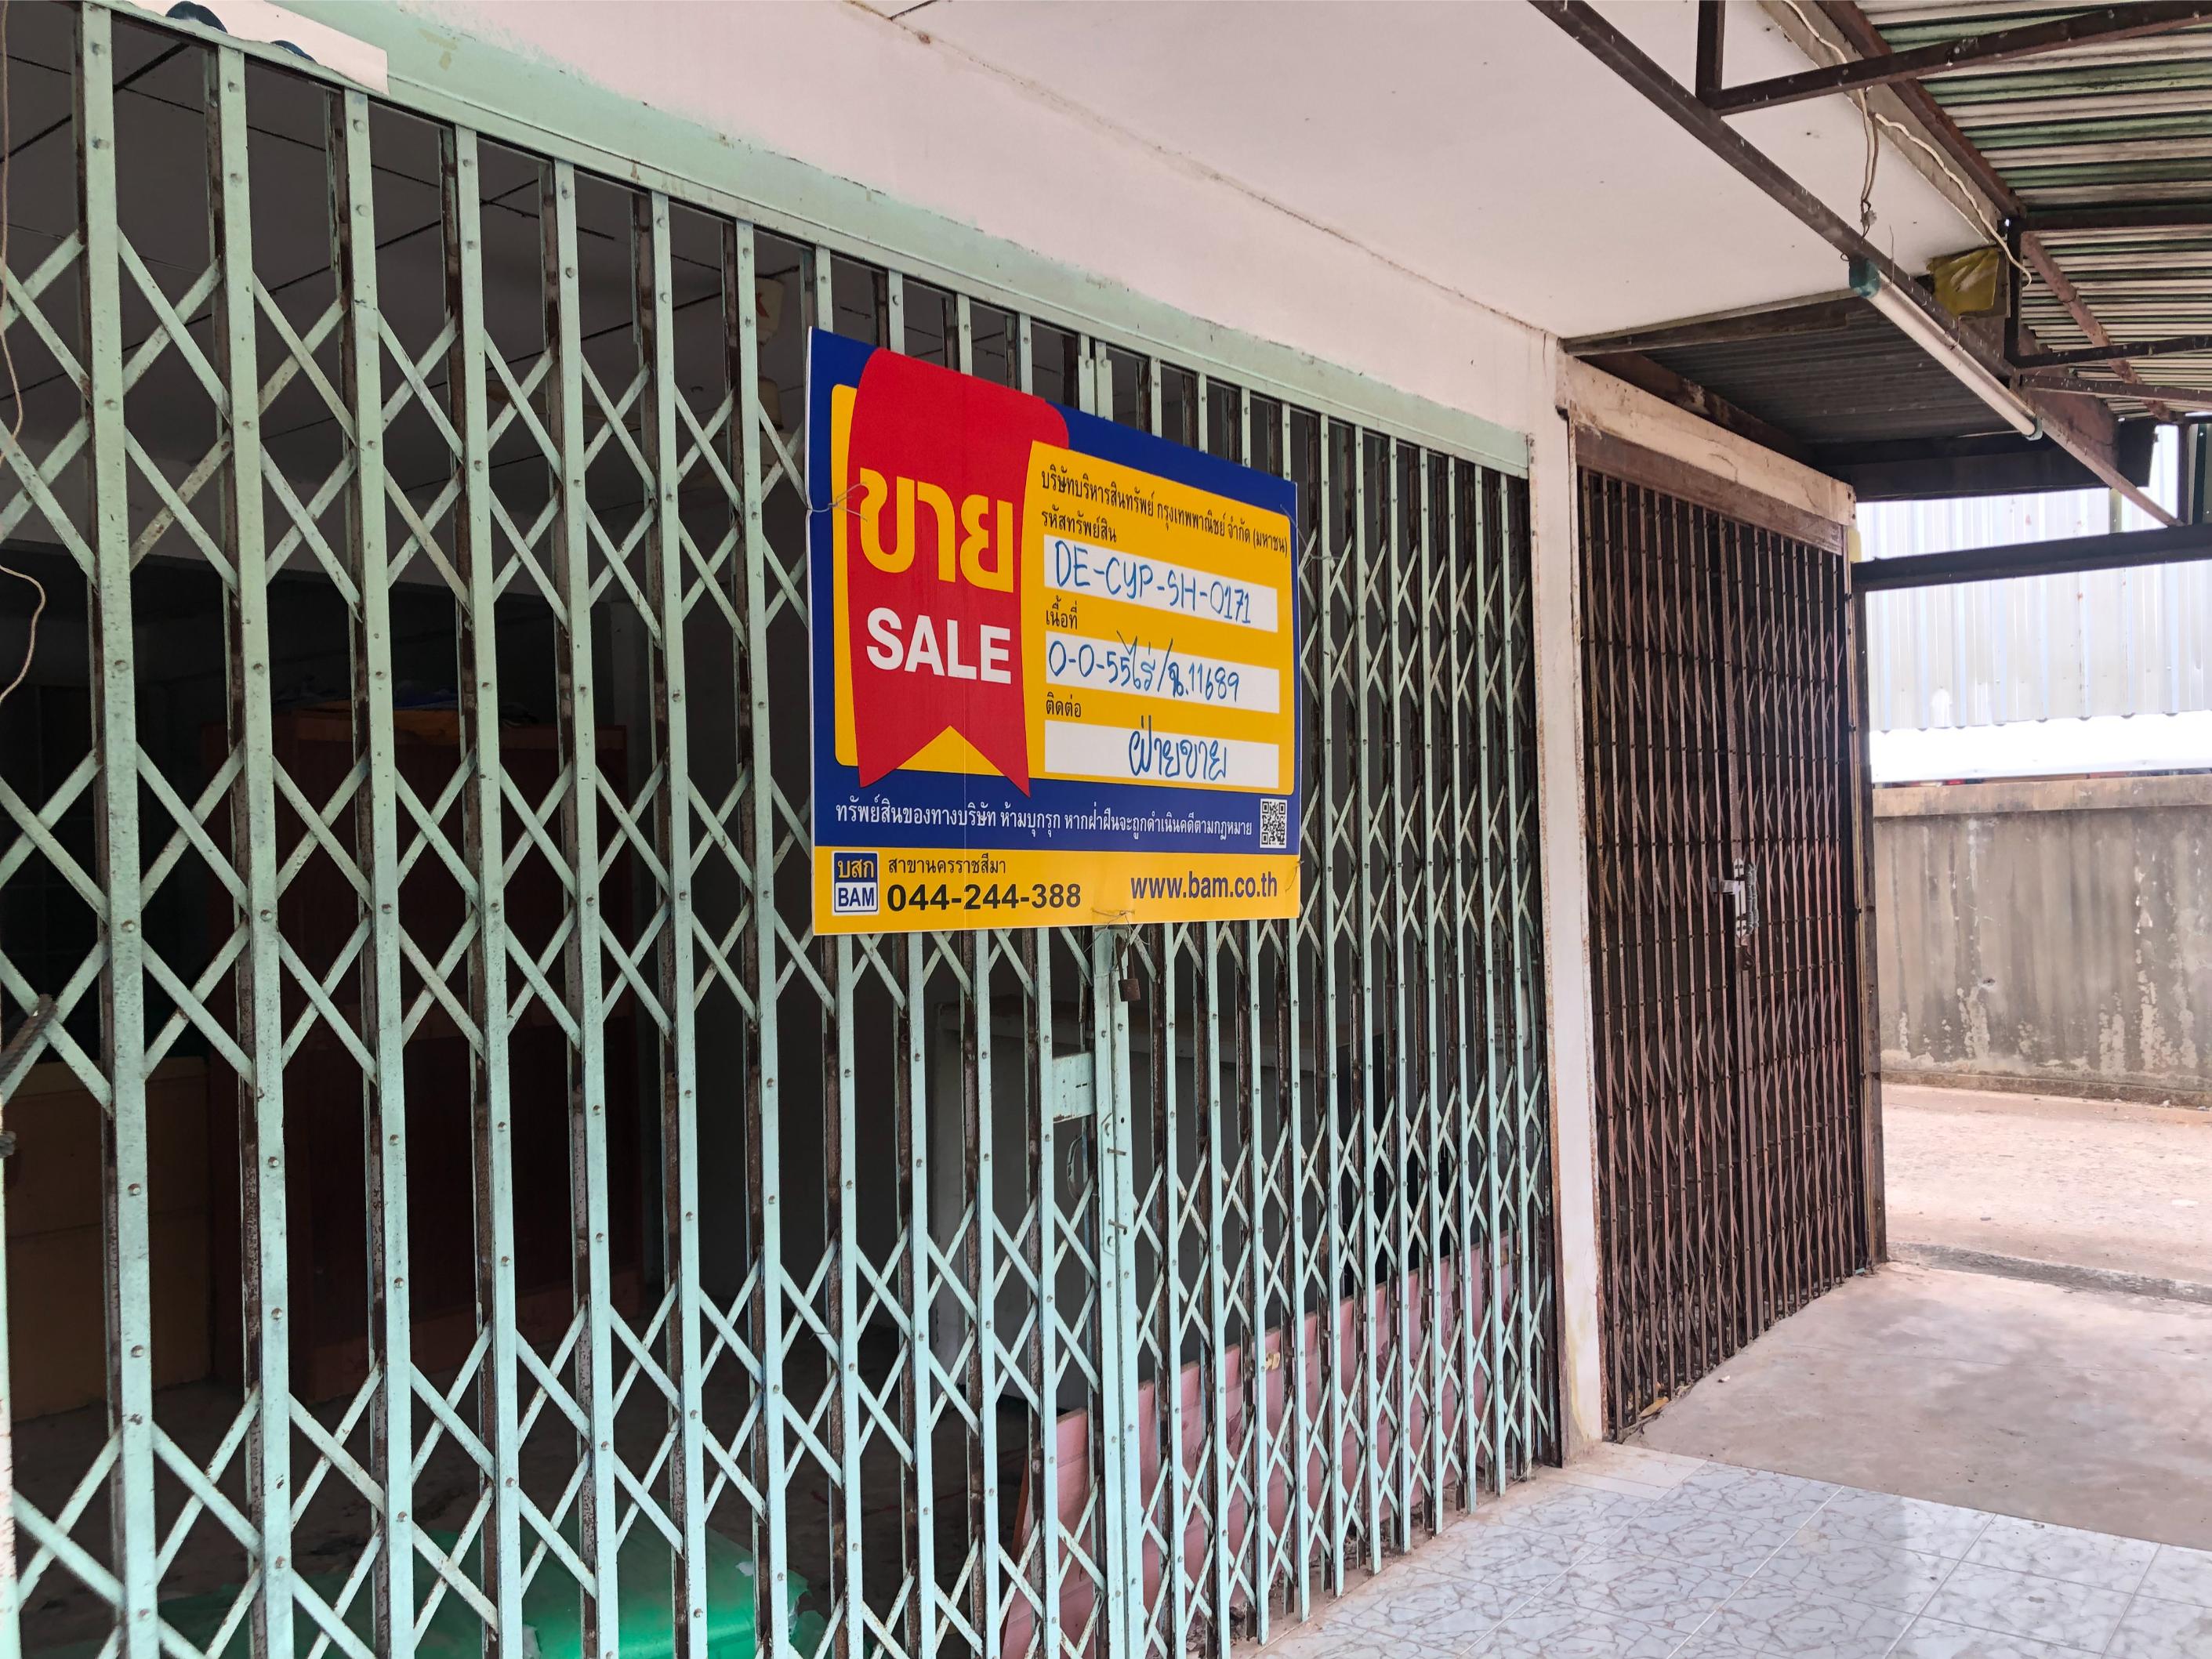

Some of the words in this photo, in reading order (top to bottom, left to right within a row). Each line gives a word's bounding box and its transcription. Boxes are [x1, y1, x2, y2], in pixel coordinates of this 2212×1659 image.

[1041, 463, 1155, 517] บริษัทบริหารสินทรัพย์
[1157, 502, 1226, 537] กรุงเทพพาณิชย์
[1227, 516, 1250, 544] จำกัด
[1253, 527, 1288, 557] (มหาชน)
[1042, 504, 1116, 543] รหัสทรัพย์สิน
[860, 467, 1014, 593] ขาย
[1046, 596, 1078, 629] เนื้อที่
[866, 607, 1011, 684] SALE
[1046, 691, 1081, 718] ติดต่อ
[1129, 715, 1227, 781] ฝ่ายขาย
[836, 794, 996, 827] ทรัพย์สินของทางบริษัท
[1000, 802, 1061, 838] ห้ามบุกรุก
[837, 859, 875, 878] บสก
[888, 853, 1006, 875] สาขานครราชสีมา
[837, 887, 875, 907] BAM
[887, 883, 1081, 912] 044-244-388
[1130, 871, 1278, 899] www.bam.co.th
